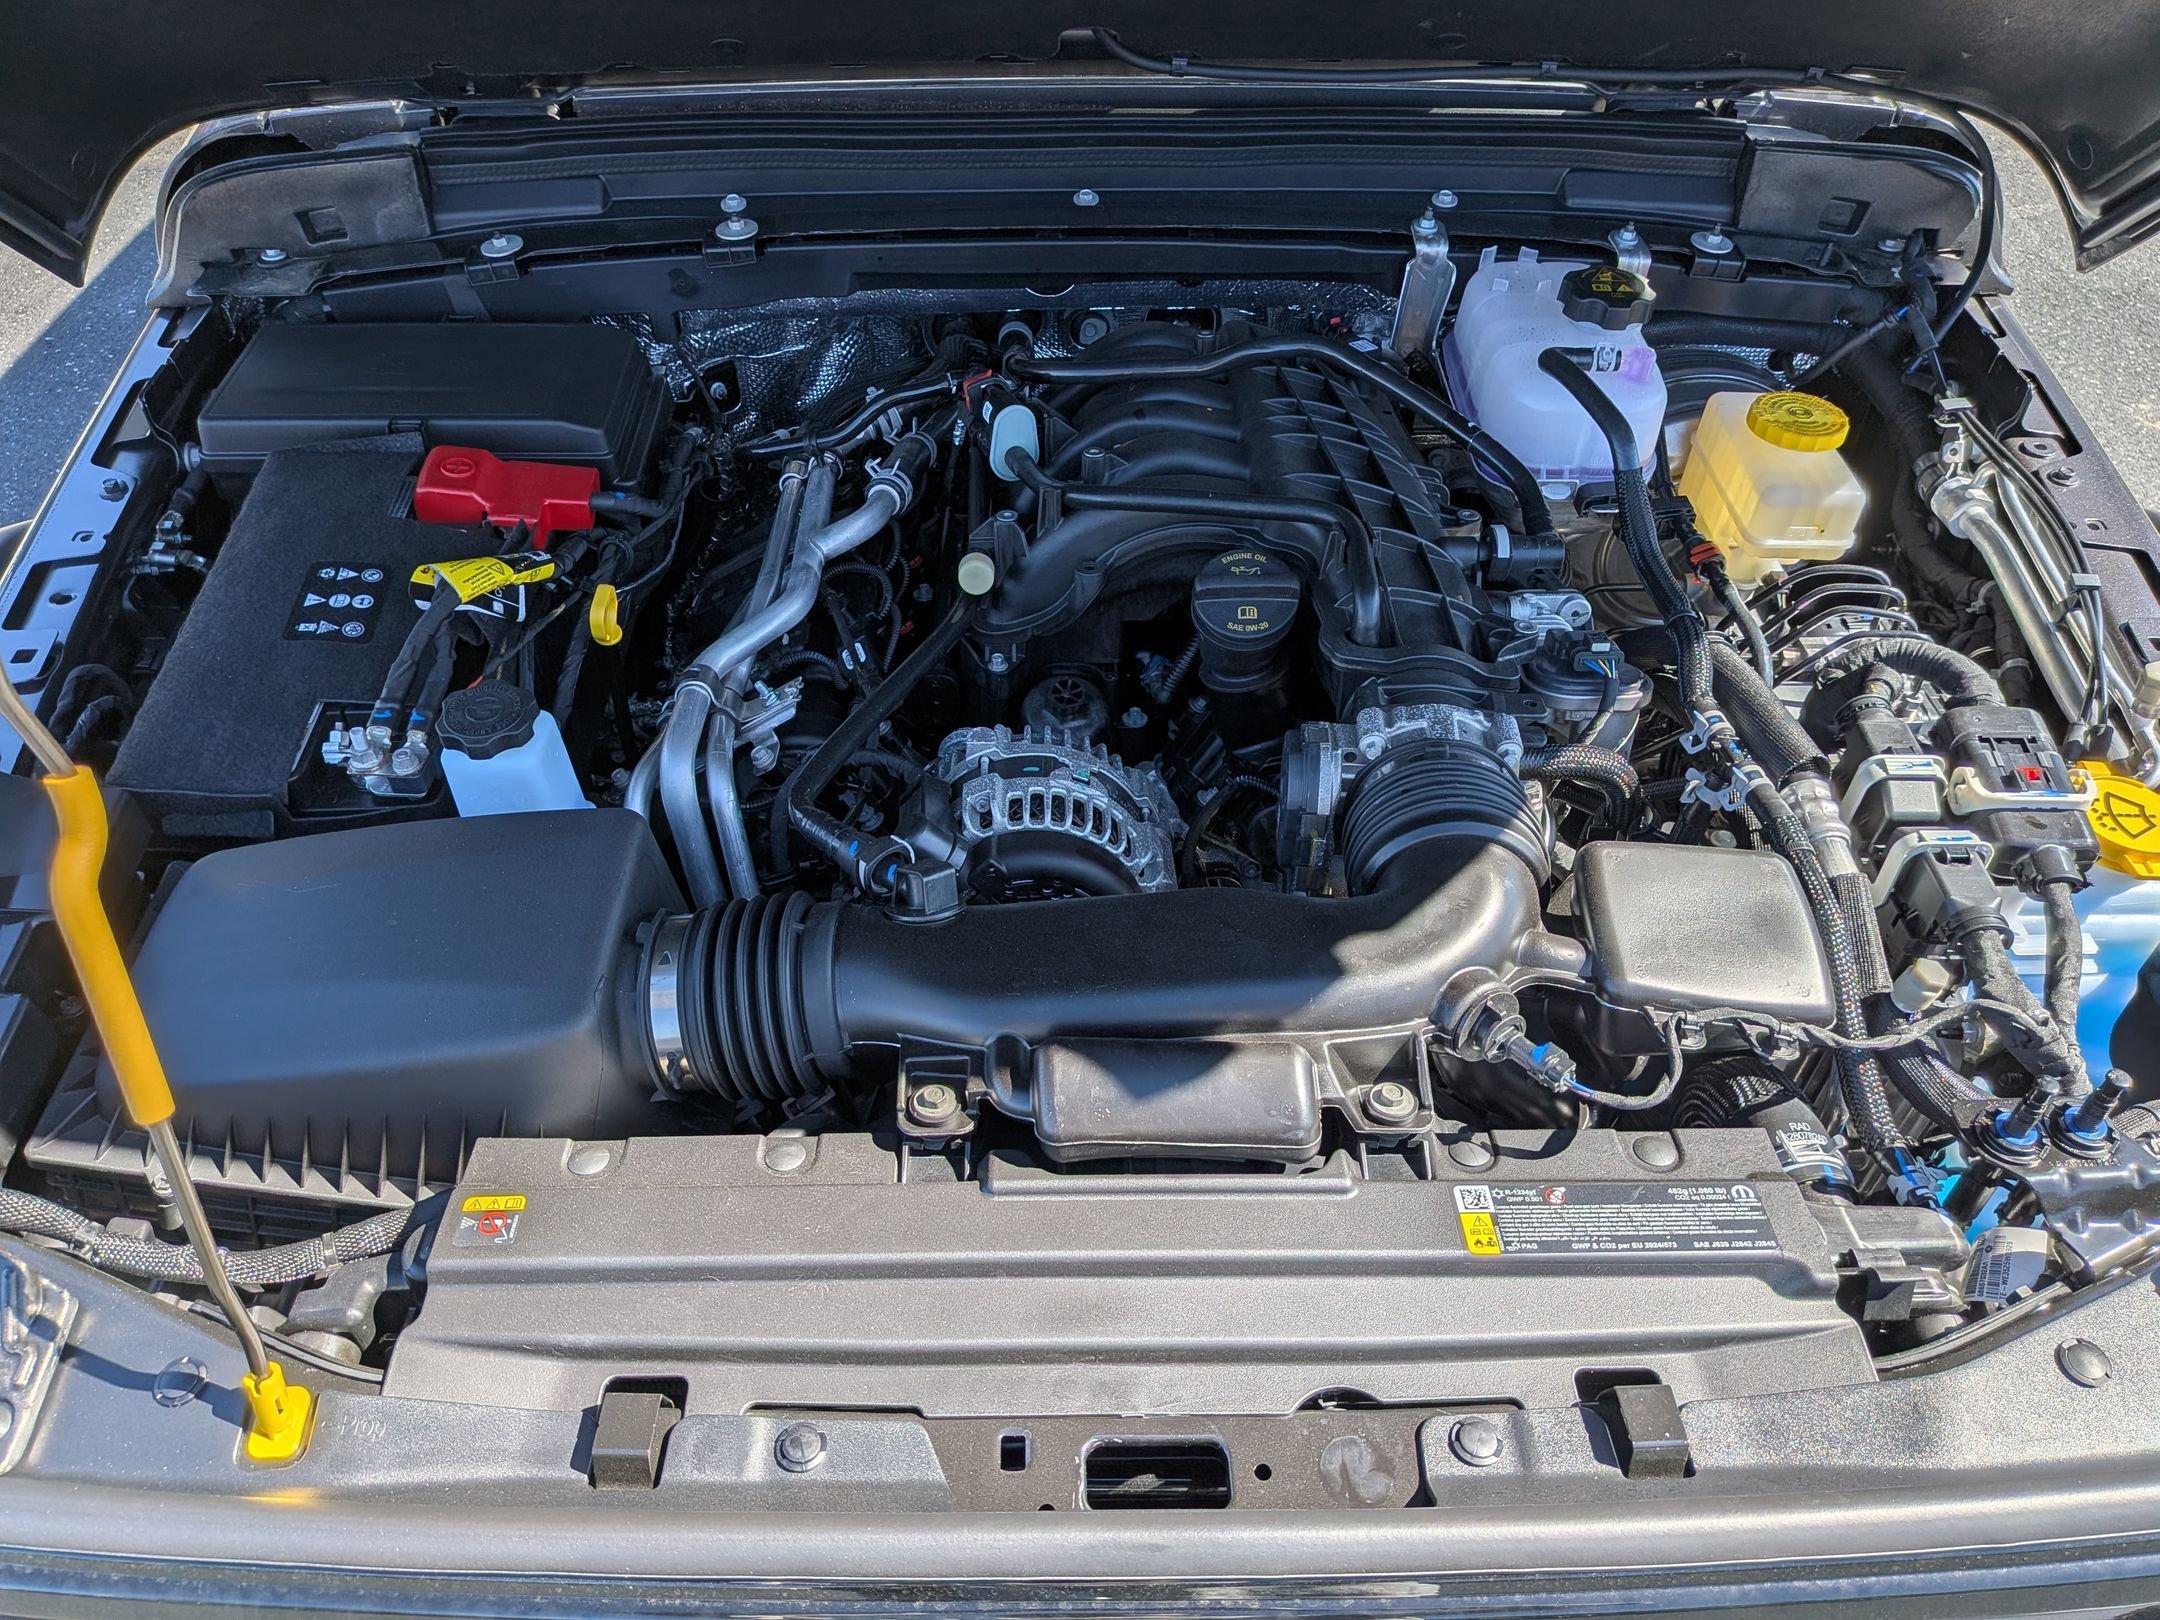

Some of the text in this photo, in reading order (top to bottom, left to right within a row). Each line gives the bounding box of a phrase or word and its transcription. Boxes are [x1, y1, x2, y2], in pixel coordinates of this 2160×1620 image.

[1221, 552, 1268, 564] ENGINE OIL
[1226, 621, 1269, 632] SAE 0W-20
[1788, 1122, 1811, 1131] RAD
[1715, 1187, 1727, 1195] lb)
[1618, 1242, 1630, 1250] per
